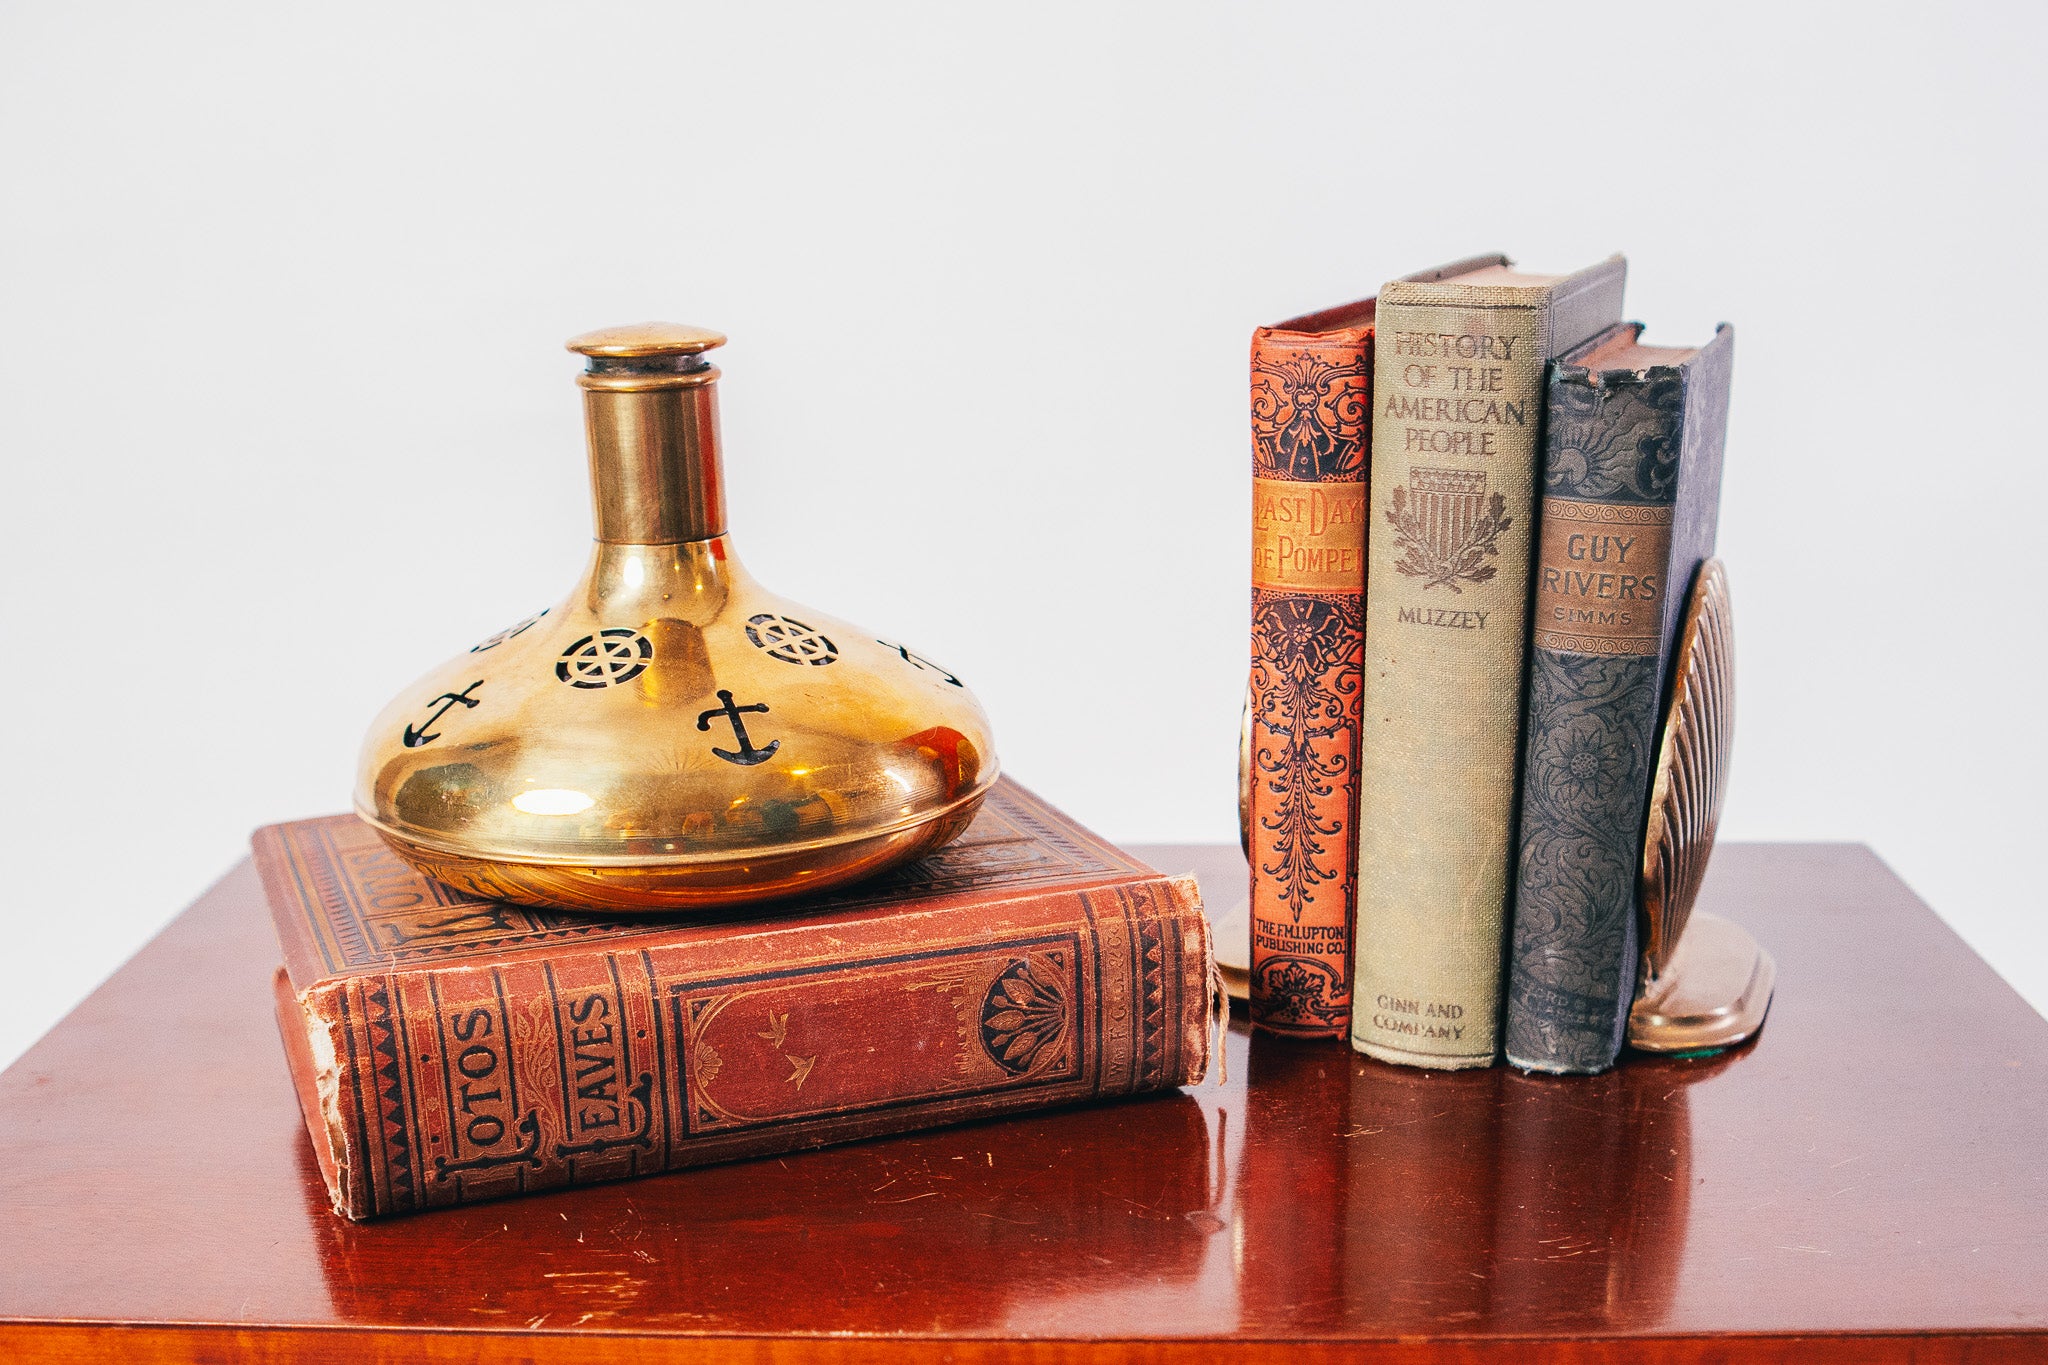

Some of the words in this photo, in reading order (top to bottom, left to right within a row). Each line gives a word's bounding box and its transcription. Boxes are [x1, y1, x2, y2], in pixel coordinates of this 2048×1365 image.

[1395, 331, 1520, 360] HISTORY
[1403, 364, 1437, 388] OF
[1448, 366, 1503, 392] THE
[1383, 394, 1525, 425] AMERICAN
[1405, 428, 1497, 455] PEOPLE
[1255, 483, 1306, 531] LAST
[1254, 547, 1275, 569] OF
[1567, 533, 1637, 563] GUY
[1542, 567, 1657, 601] RIVERS
[1399, 606, 1490, 629] MUZZEY
[1554, 606, 1632, 626] SIMMS
[1256, 918, 1275, 936] THE
[1256, 934, 1324, 955] PUBLISHING
[1377, 994, 1420, 1015] GINN
[1424, 1003, 1464, 1019] AND
[1373, 1014, 1465, 1039] COMPANY
[556, 993, 654, 1159] LEAVES
[434, 1007, 543, 1183] LOTOS
